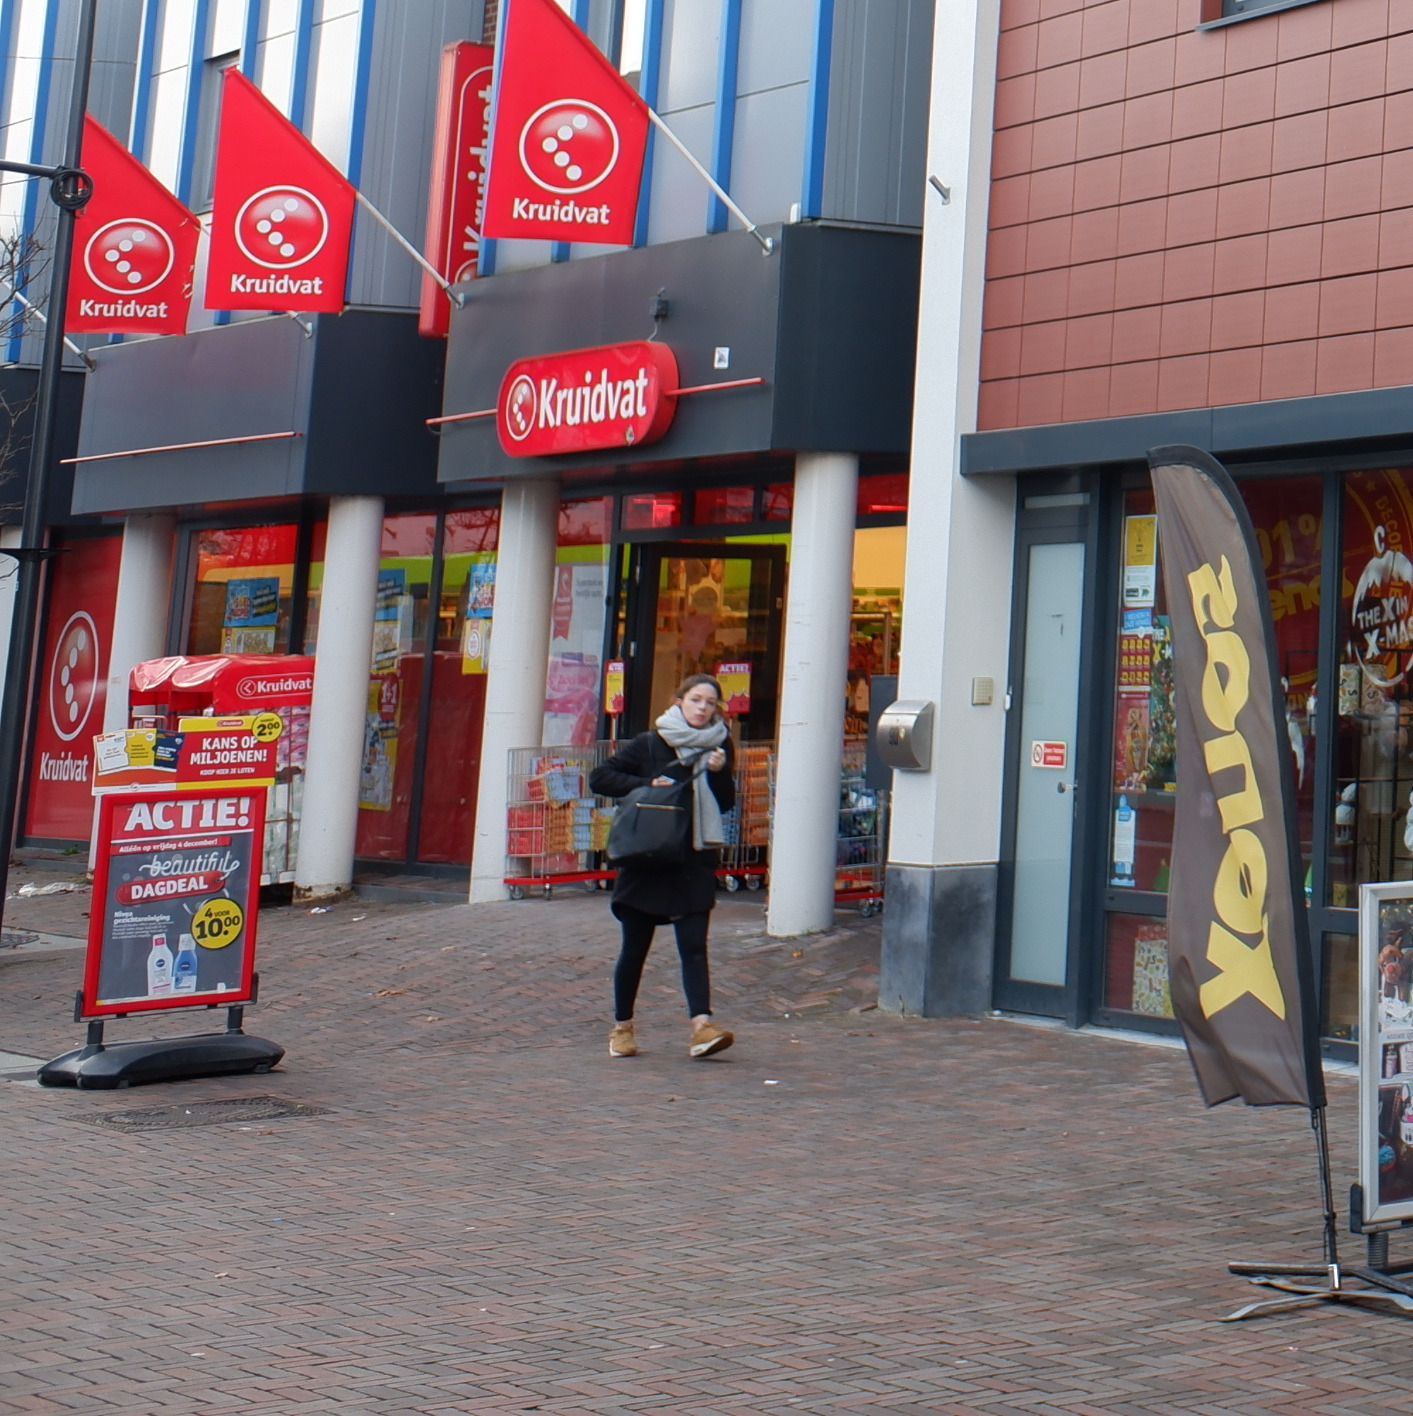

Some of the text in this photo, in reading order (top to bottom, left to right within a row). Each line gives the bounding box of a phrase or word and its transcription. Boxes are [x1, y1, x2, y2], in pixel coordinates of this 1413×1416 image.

[511, 196, 610, 225] Kruidvat
[230, 272, 323, 296] Kruidvat
[79, 298, 168, 319] Kruidvat
[538, 367, 648, 429] Kruidvat
[1357, 606, 1381, 629] THE
[1380, 597, 1399, 625] X
[719, 663, 749, 673] ACTIE!
[257, 676, 312, 693] Kruidvat
[257, 722, 280, 736] 2.00
[202, 736, 259, 750] KANS OP
[39, 751, 89, 783] Kruidvat
[189, 749, 268, 765] MILJOENEN!
[1187, 554, 1286, 1021] xenos
[123, 797, 250, 831] ACTIE!
[142, 845, 151, 853] op
[152, 841, 177, 852] vrijdag
[183, 838, 218, 848] december!
[139, 850, 241, 878] beautiful
[131, 876, 209, 900] DAGDEAL
[204, 908, 230, 918] 4 VOOR
[195, 915, 240, 940] 10.00
